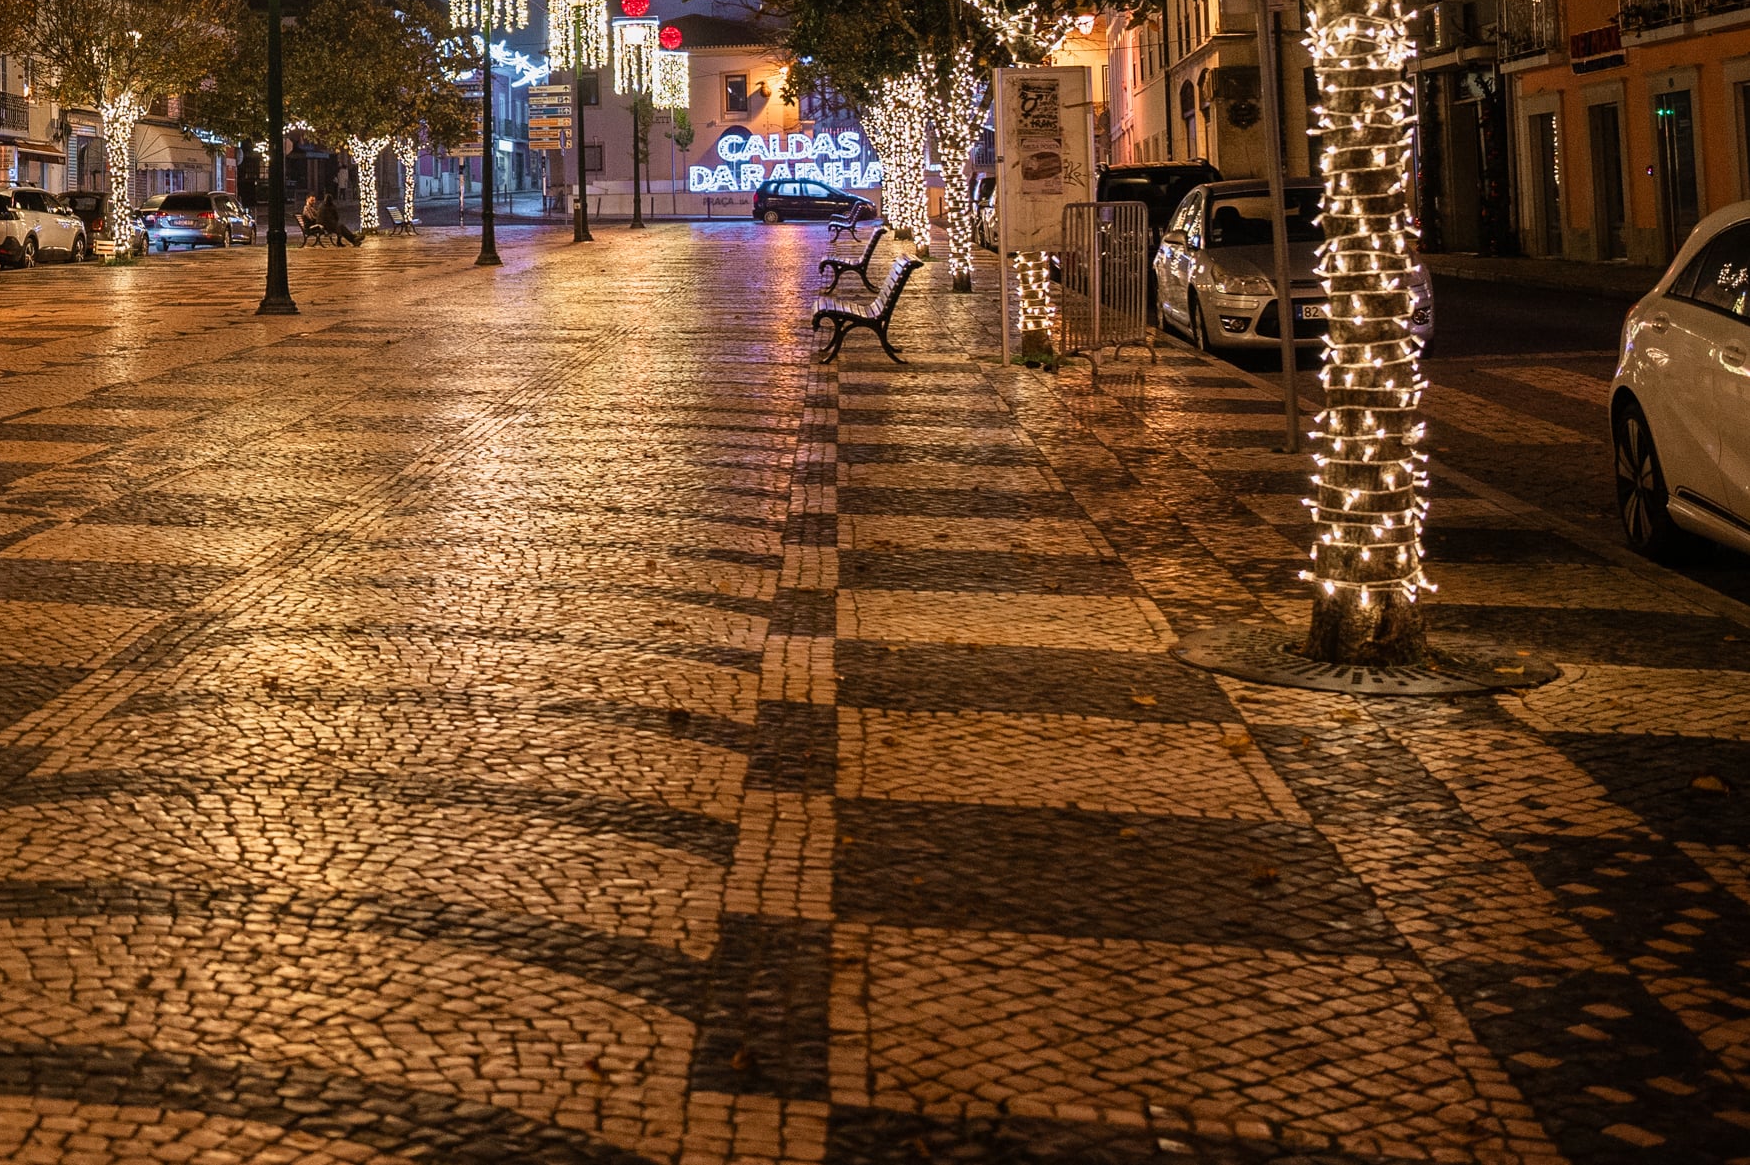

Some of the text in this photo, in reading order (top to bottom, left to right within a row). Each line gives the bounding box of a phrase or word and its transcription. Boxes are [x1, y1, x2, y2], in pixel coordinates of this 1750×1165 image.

[717, 131, 861, 162] CALDAS
[689, 161, 884, 192] DA RAINHA
[703, 197, 734, 207] PRAÇA
